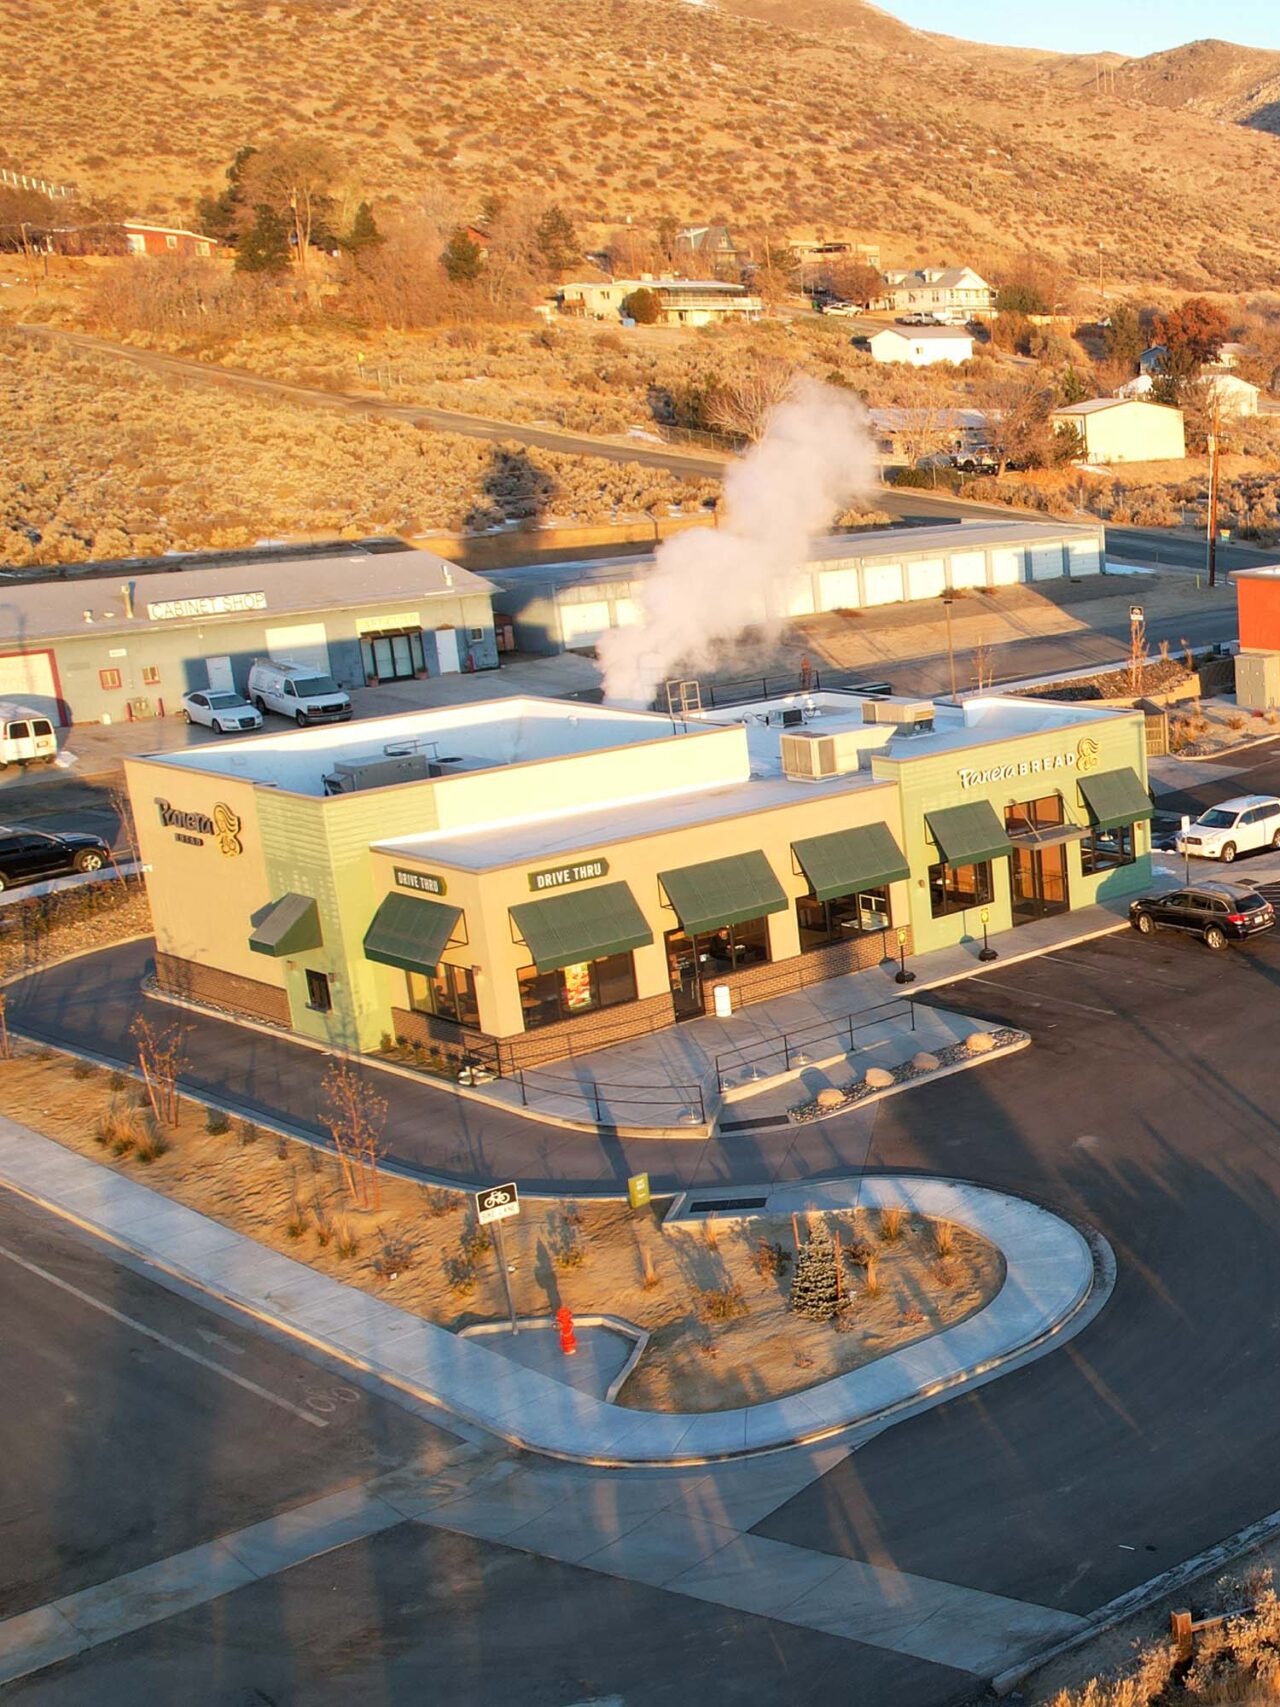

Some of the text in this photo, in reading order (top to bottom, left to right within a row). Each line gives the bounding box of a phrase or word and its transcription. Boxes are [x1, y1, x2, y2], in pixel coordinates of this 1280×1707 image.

[151, 592, 266, 620] CABINET SHOP
[957, 752, 1077, 790] Panera BREAD
[154, 796, 215, 836] Panera
[397, 871, 439, 893] DRIVE THRU
[536, 862, 602, 889] DRIVE THRU
